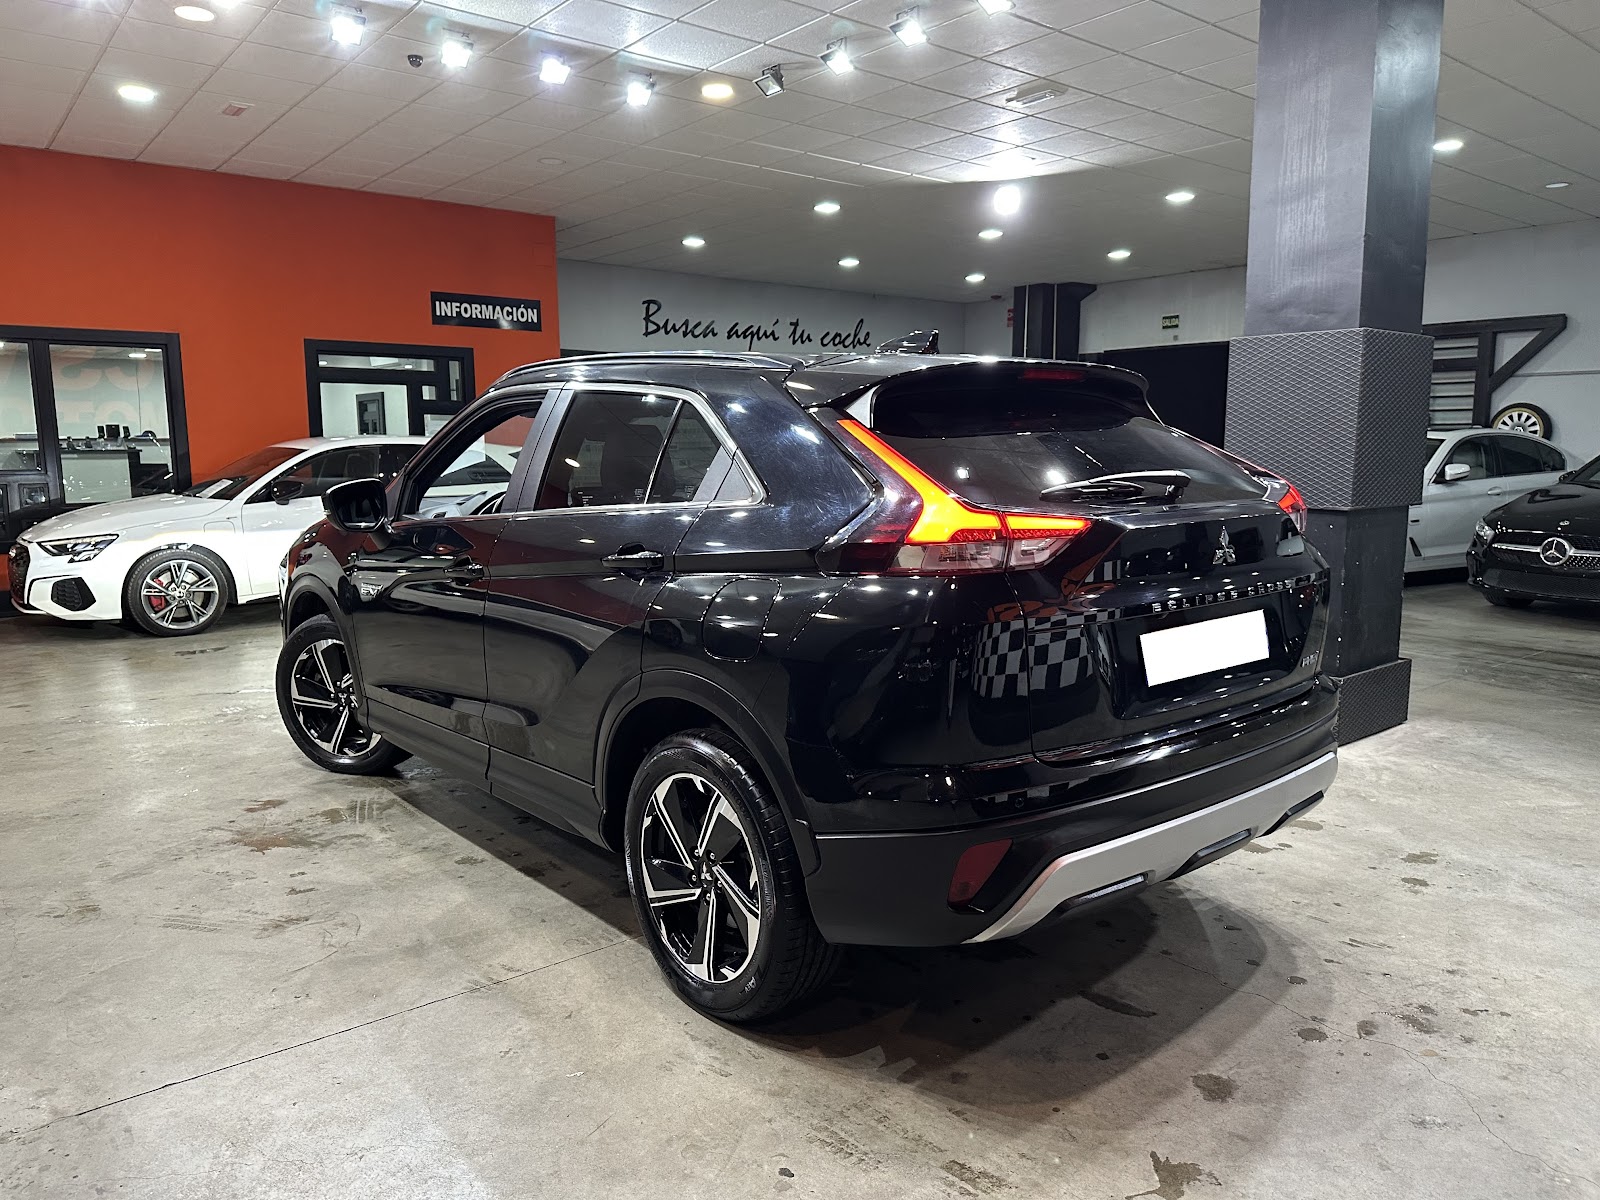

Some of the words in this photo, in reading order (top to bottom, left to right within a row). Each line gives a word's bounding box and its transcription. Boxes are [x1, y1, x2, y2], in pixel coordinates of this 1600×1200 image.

[435, 301, 538, 323] INFORMACIÓN
[641, 299, 718, 339] Busca
[726, 318, 780, 351] aquí
[788, 318, 812, 345] tu
[820, 318, 871, 349] coche
[1152, 590, 1238, 613] ECLIPSE
[1247, 579, 1292, 596] CROSS
